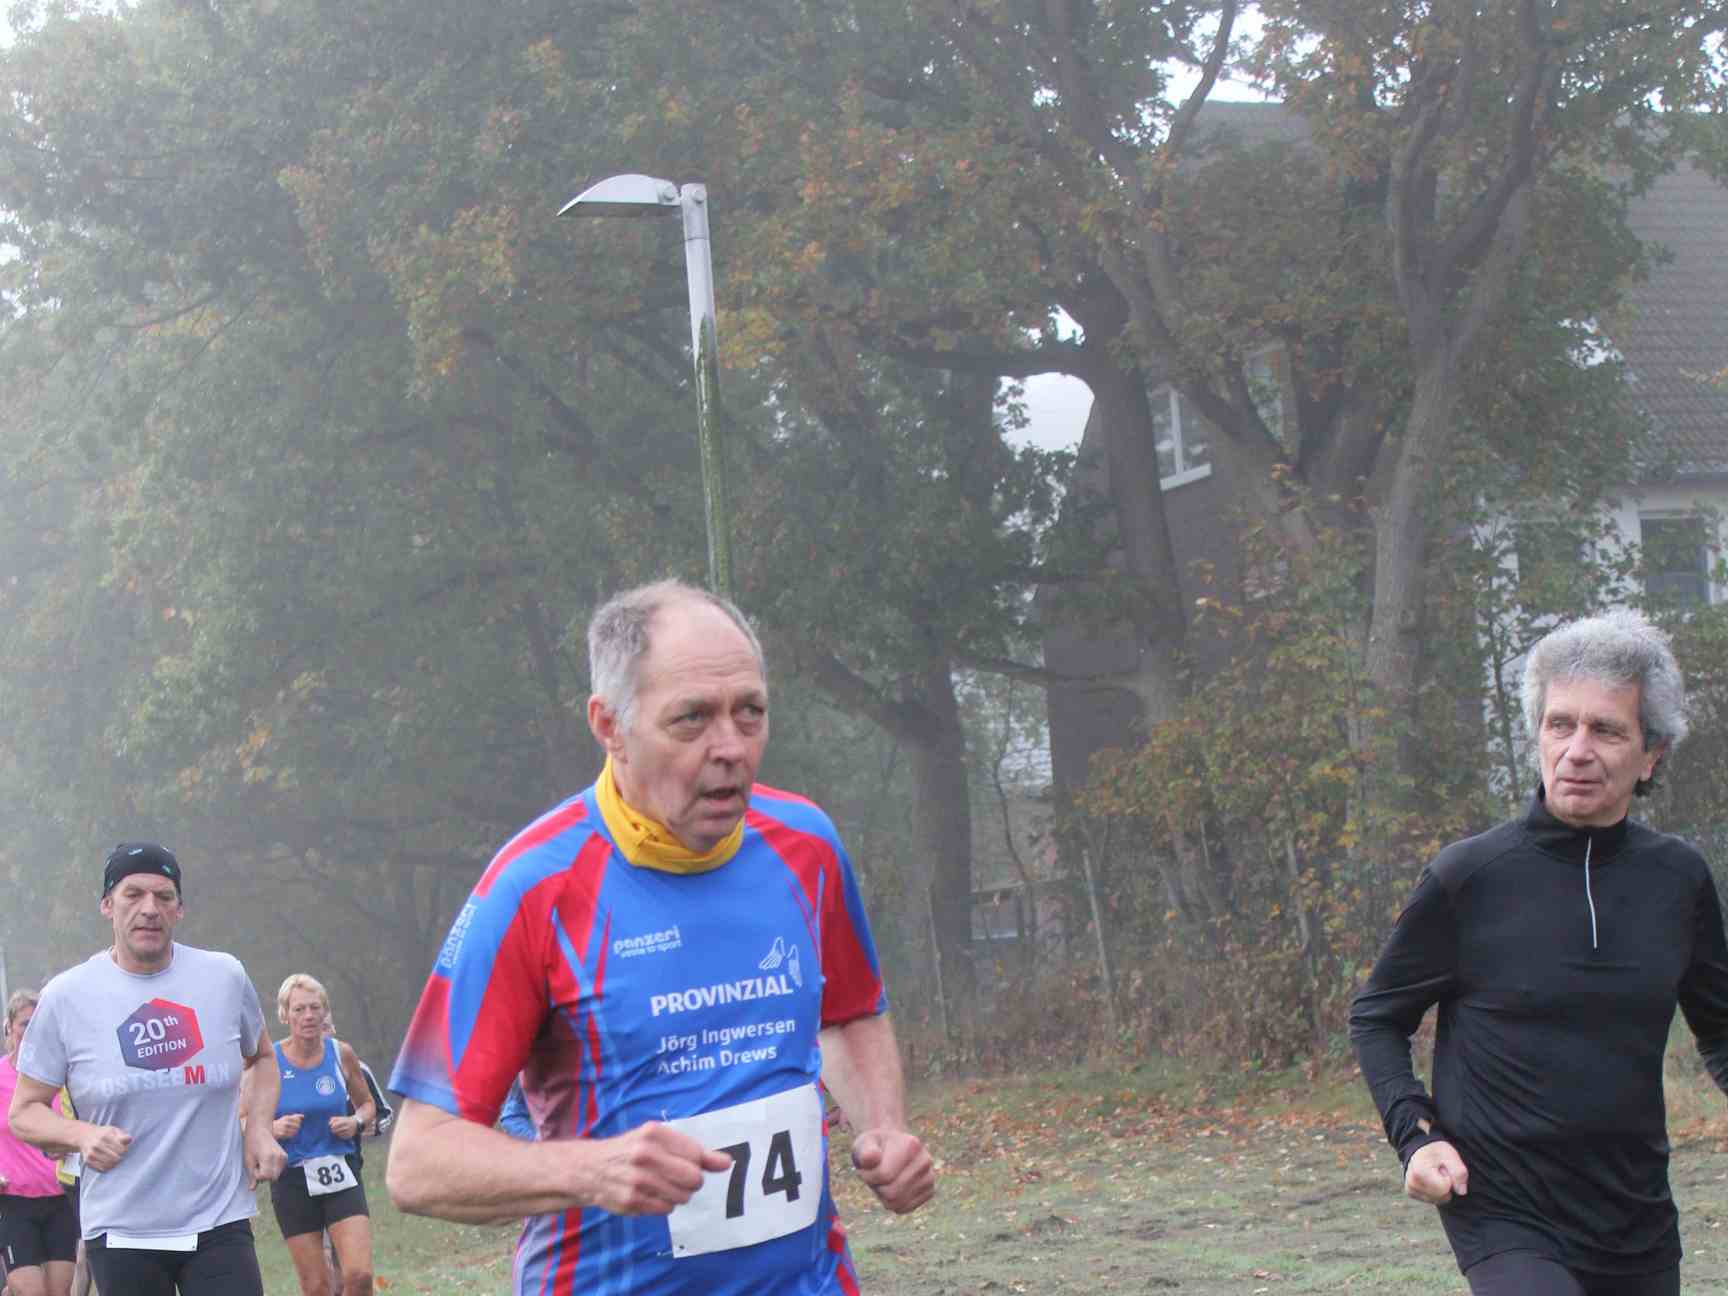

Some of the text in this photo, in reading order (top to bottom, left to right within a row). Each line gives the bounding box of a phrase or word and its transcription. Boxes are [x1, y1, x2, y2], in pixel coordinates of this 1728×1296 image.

[650, 974, 794, 1016] PROVINZIAL
[128, 1015, 179, 1046] 20th
[656, 1019, 796, 1054] Jörg Ingwersen
[137, 1038, 188, 1058] EDITION
[657, 1046, 777, 1075] Achim Drews
[316, 1162, 346, 1187] 83
[712, 1129, 803, 1219] 74
